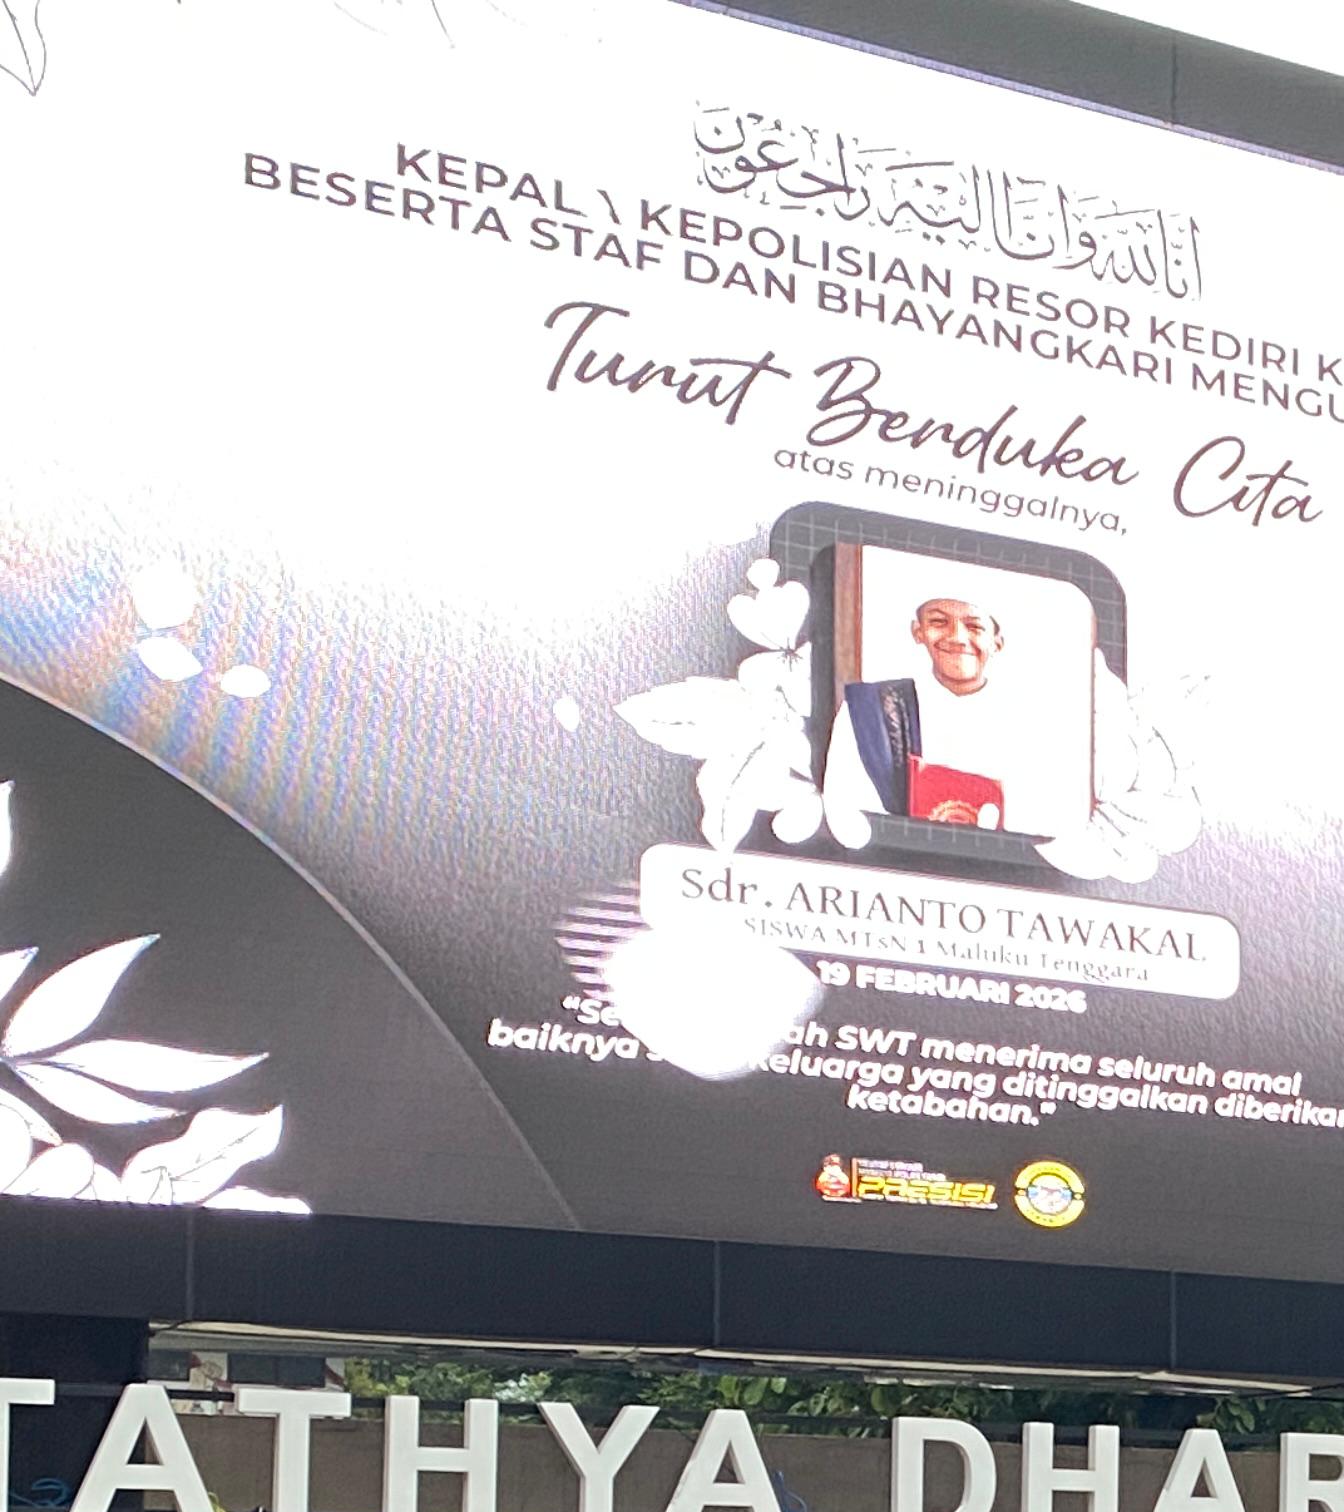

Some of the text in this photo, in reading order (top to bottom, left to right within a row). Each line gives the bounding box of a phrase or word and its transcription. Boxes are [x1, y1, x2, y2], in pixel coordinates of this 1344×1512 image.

[244, 152, 511, 241] BESERTA
[530, 217, 662, 270] STAF
[684, 249, 796, 304] DAN
[817, 280, 1172, 385] BHAYANGKARI
[641, 200, 952, 297] KEPOLISIAN
[972, 274, 1130, 337] RESOR
[1149, 316, 1299, 376] KEDIRI
[544, 301, 1323, 526] Turut Berduka Cita
[774, 446, 1128, 535] atas meninggalnya,
[787, 882, 986, 934] ARIANTO
[997, 909, 1206, 961] TAWAKAL
[816, 960, 1087, 1014] 19 FEBRUARI 2026
[487, 1018, 639, 1062] baiknya
[908, 1064, 996, 1099] yang
[1002, 1070, 1208, 1116] ditinggalkan
[835, 1024, 917, 1057] SWT
[920, 1036, 1091, 1074] menerima
[1097, 1056, 1215, 1088] seluruh
[1221, 1070, 1302, 1097] amal
